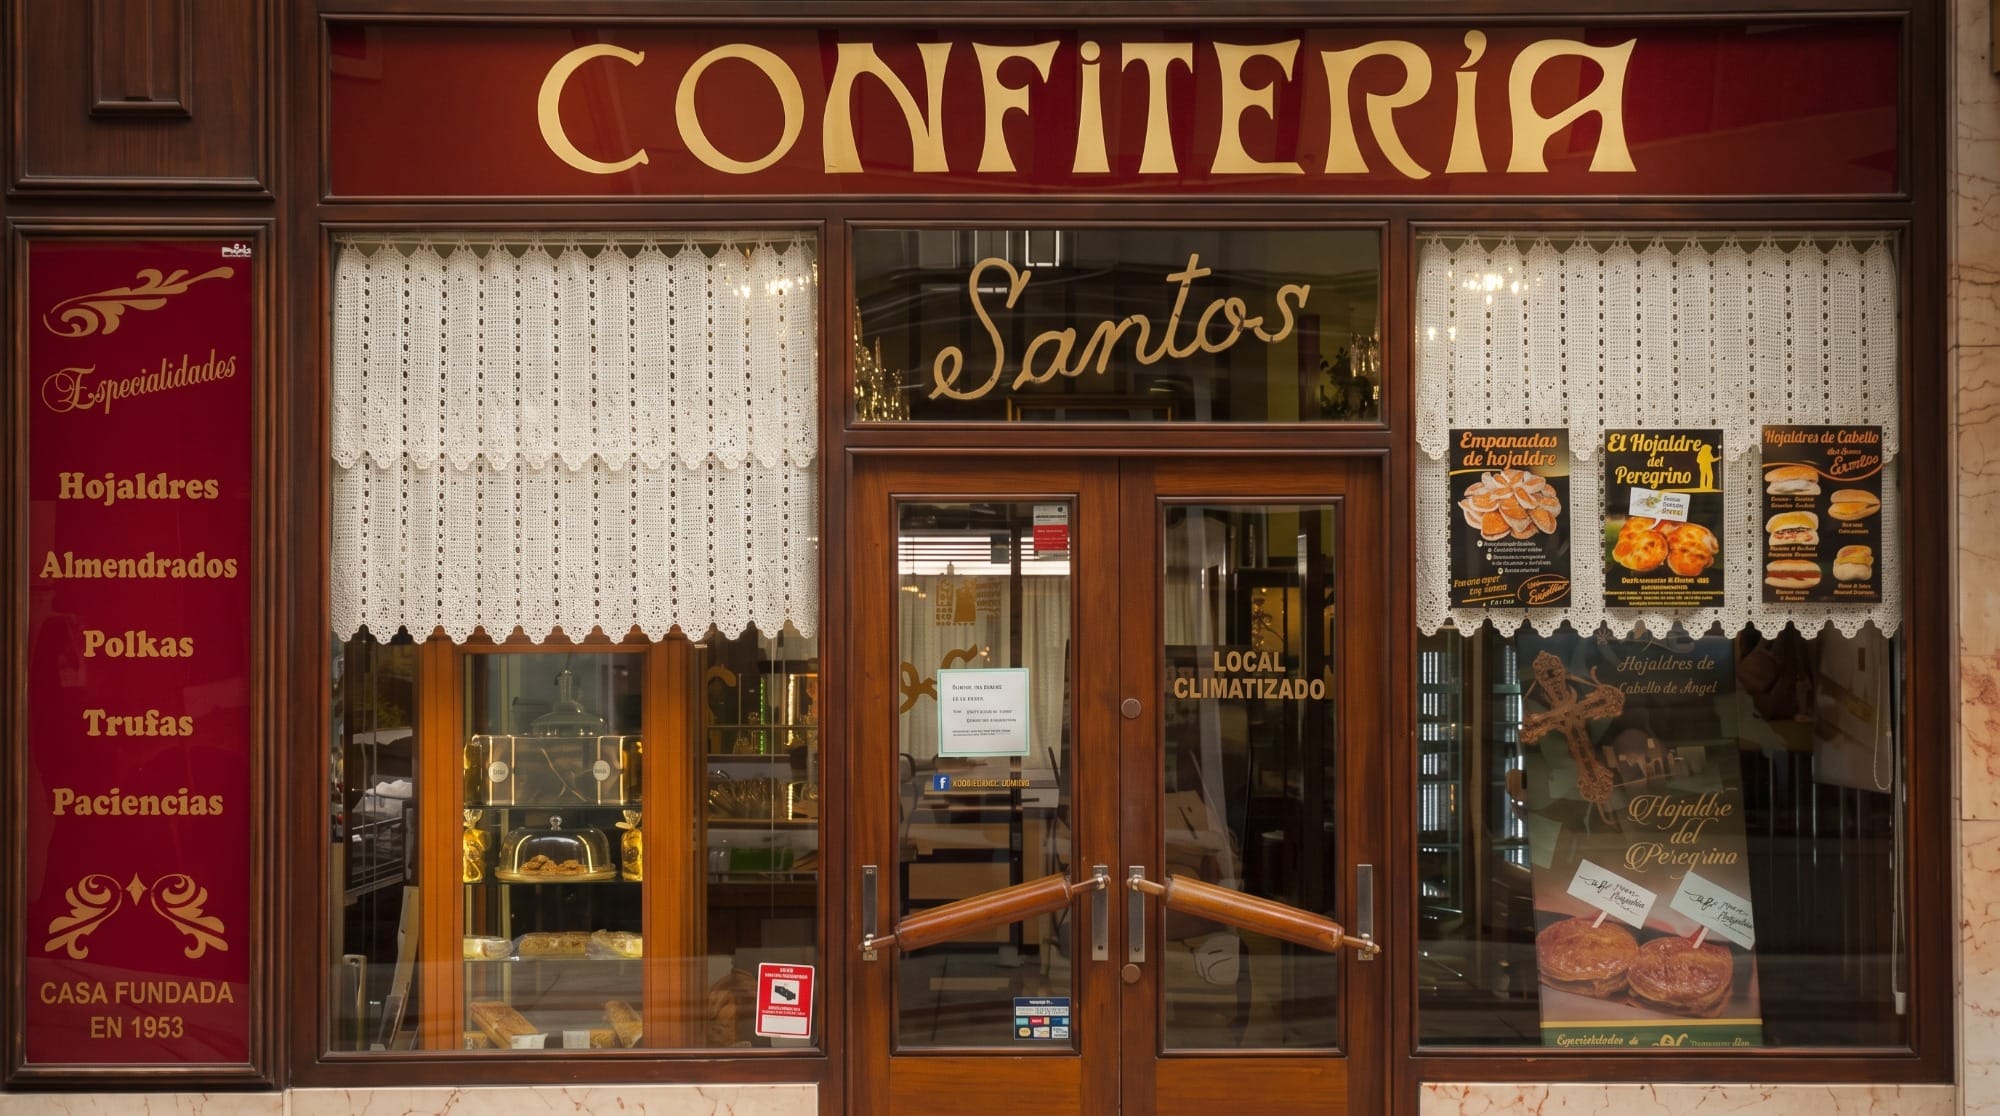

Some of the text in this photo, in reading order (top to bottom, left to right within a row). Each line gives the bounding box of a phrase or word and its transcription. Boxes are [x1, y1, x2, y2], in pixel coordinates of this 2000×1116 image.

[928, 253, 1310, 400] Santos
[42, 348, 236, 414] Especialidades
[1460, 431, 1558, 452] Empanadas
[1607, 433, 1702, 457] El Hojaldre
[1764, 429, 1879, 447] Hojaldres de Cabello
[1463, 450, 1556, 470] de hojaldre
[1647, 456, 1664, 467] del
[59, 472, 219, 506] Hojaldres
[1615, 466, 1692, 489] Peregrino
[40, 551, 238, 578] Almendrados
[83, 630, 194, 658] Polkas
[1213, 651, 1286, 673] LOCAL
[1616, 654, 1715, 676] Hojaldres de
[1173, 677, 1326, 700] CLIMATIZADO
[1620, 681, 1661, 694] Cabello
[1663, 681, 1678, 694] de
[83, 709, 194, 737] Trufas
[52, 788, 224, 816] Paciencias
[1627, 791, 1733, 831] Hojaldre
[1670, 818, 1720, 845] del
[40, 982, 234, 1005] CASA FUNDADA
[91, 1017, 184, 1039] EN 1953
